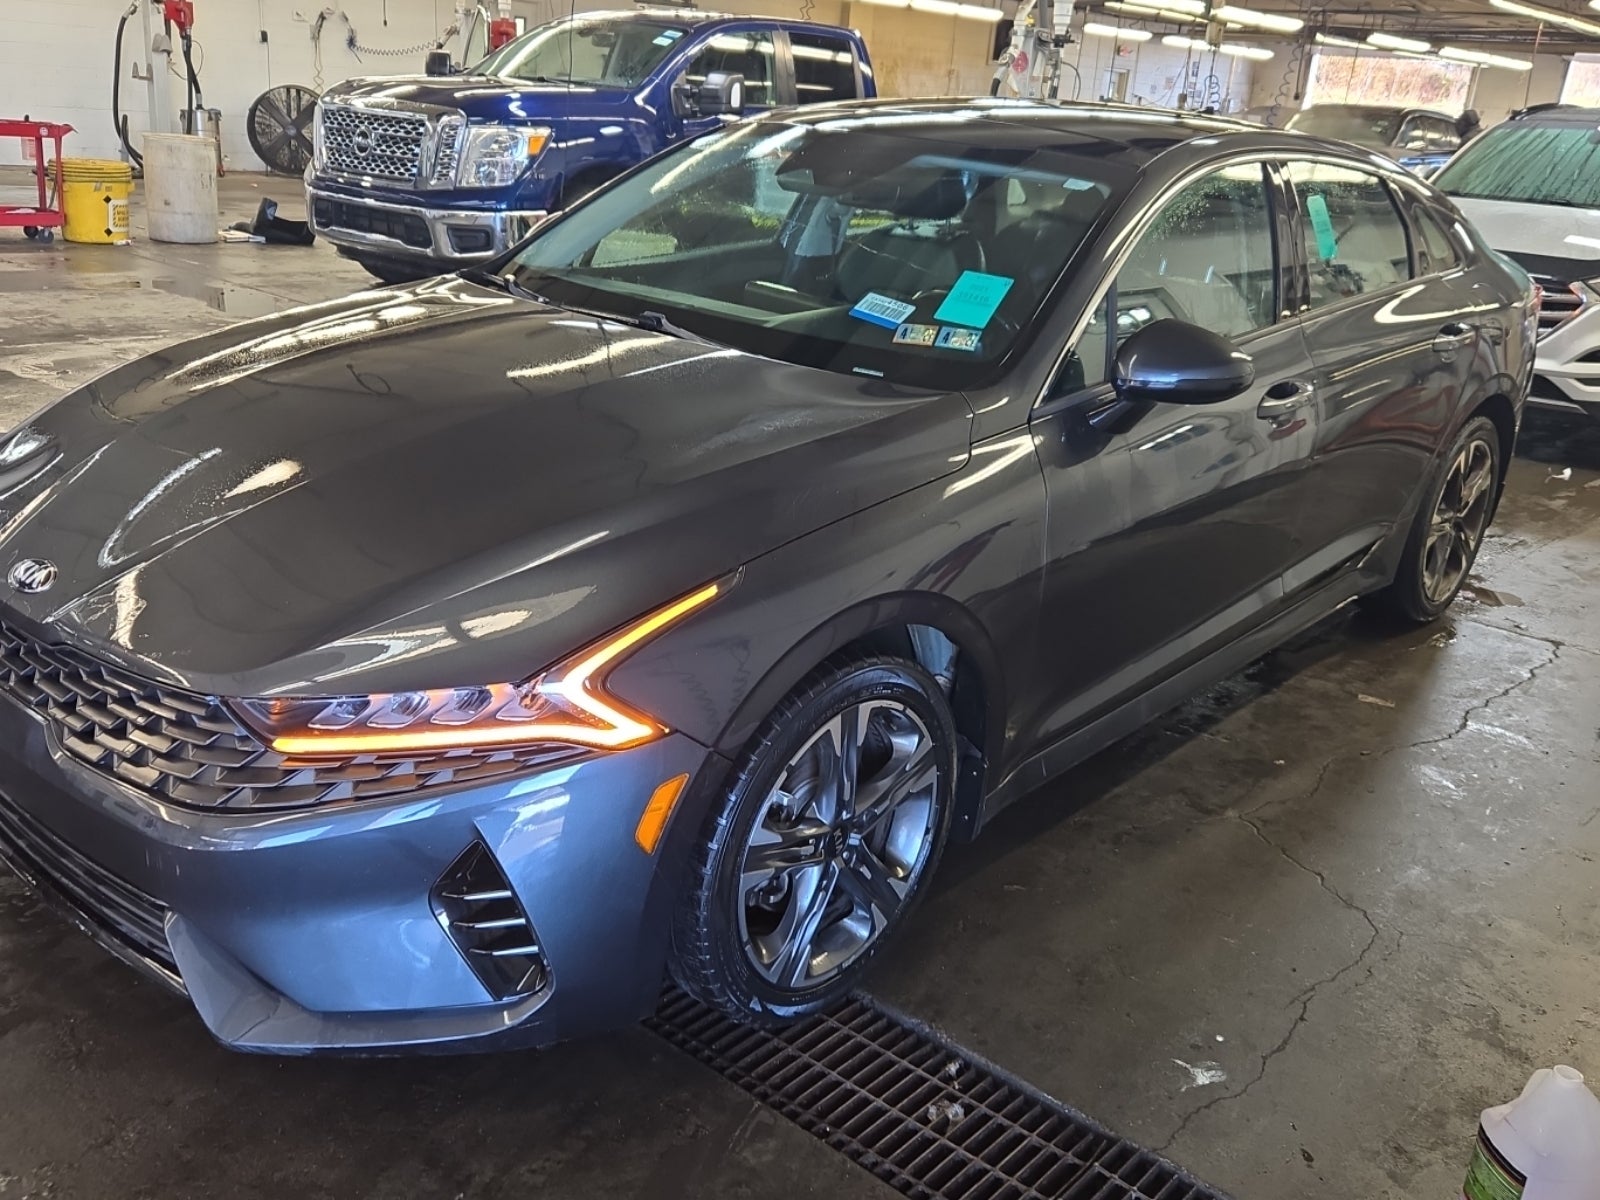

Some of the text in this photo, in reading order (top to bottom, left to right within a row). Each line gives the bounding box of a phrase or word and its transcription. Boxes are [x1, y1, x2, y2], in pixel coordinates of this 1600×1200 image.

[901, 327, 908, 340] 4
[943, 331, 951, 345] 4
[833, 828, 843, 854] KIA
